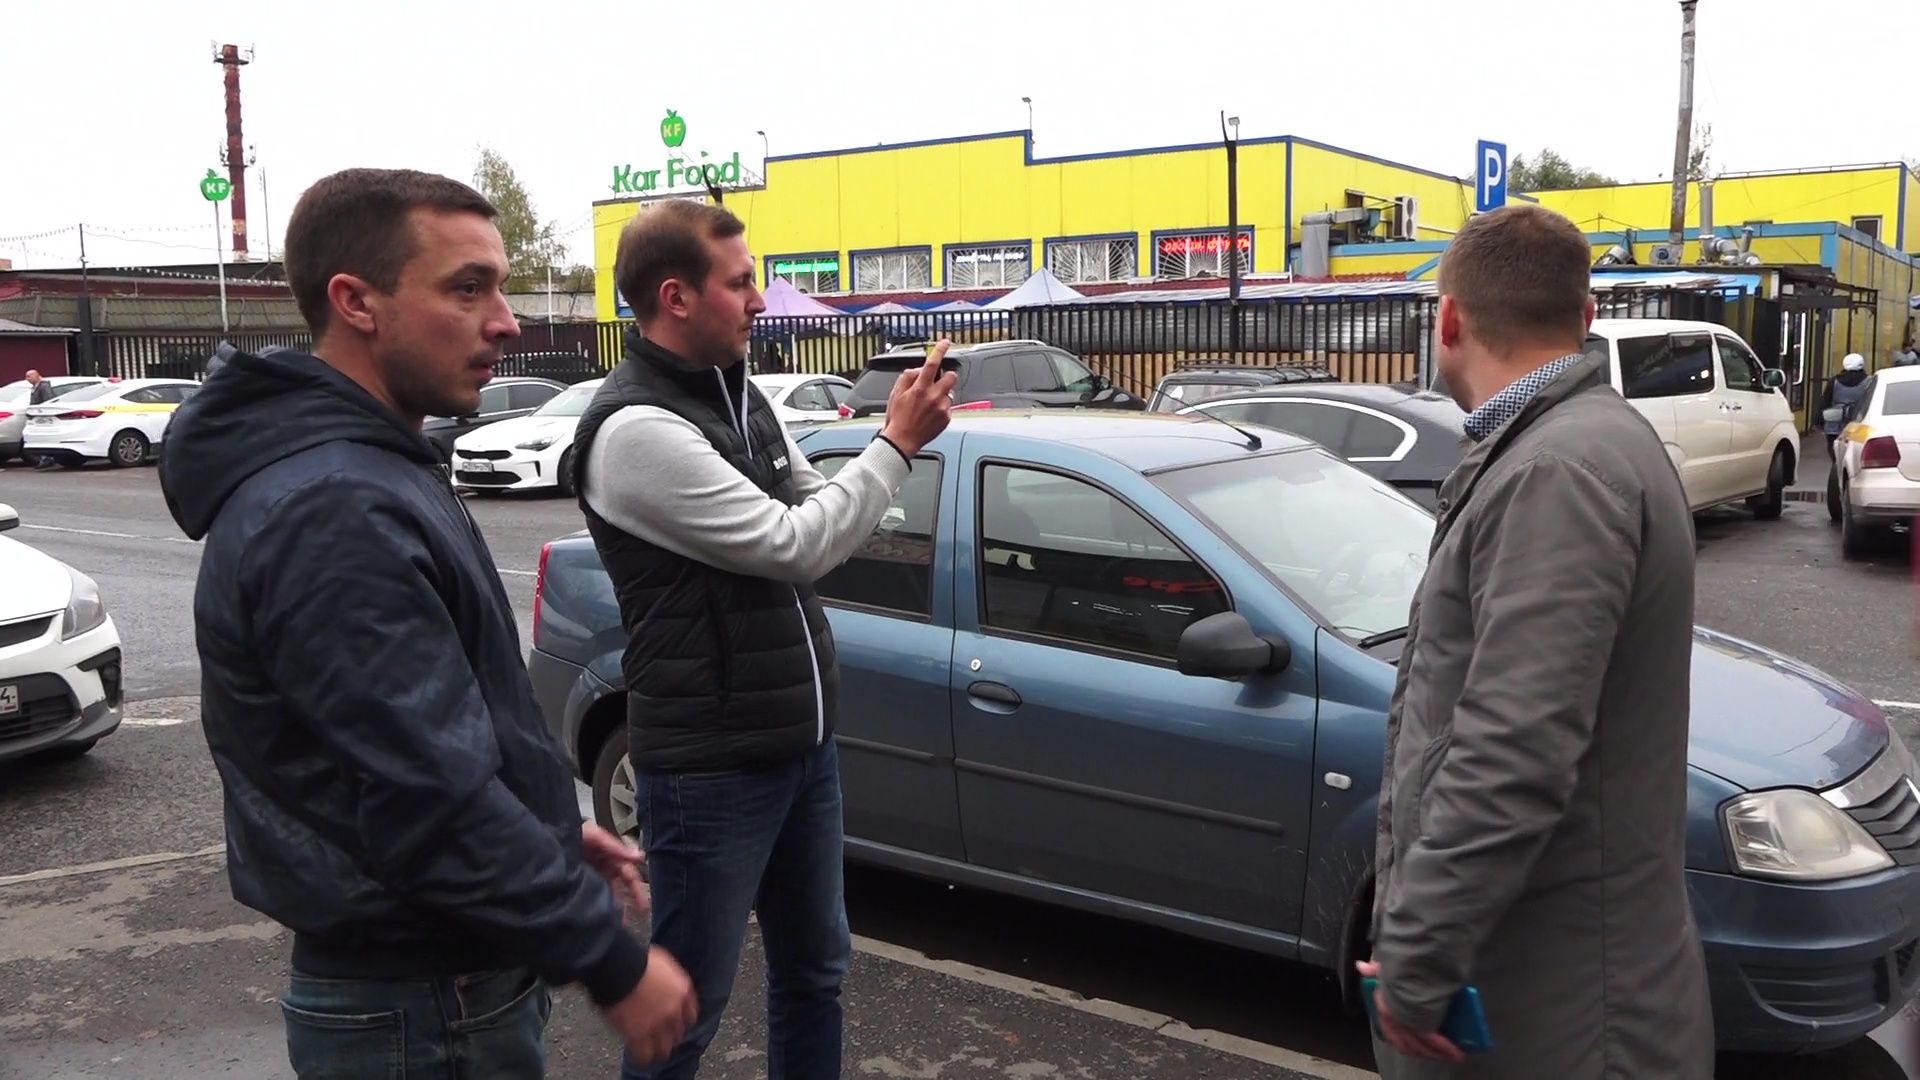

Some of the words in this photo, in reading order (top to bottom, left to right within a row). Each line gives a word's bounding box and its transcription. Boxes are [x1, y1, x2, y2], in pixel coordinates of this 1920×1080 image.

[663, 123, 681, 137] KF
[613, 164, 661, 193] Kar
[667, 152, 741, 188] Food
[1484, 148, 1502, 206] P
[206, 182, 226, 194] KF
